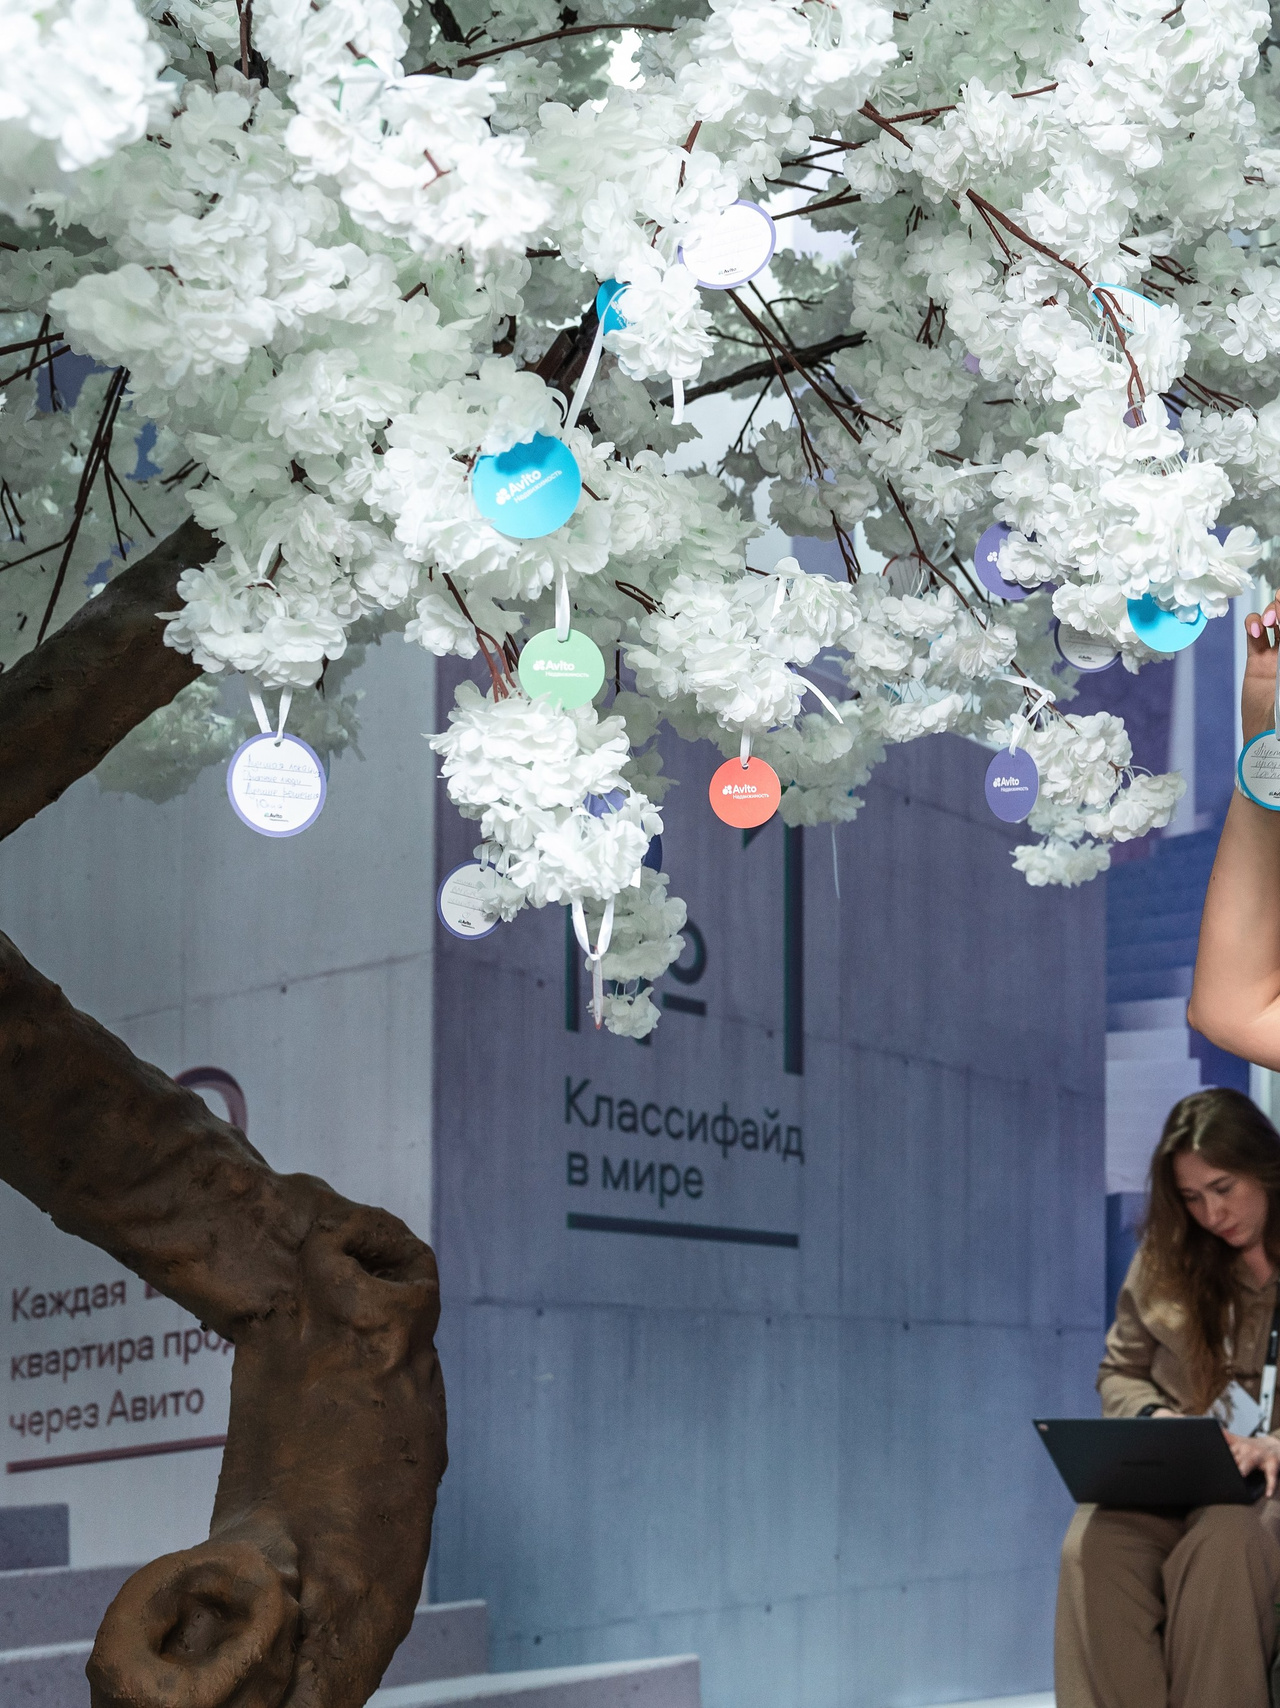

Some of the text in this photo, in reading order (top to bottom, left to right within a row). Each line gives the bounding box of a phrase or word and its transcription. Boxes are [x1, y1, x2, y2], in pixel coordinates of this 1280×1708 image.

[508, 470, 542, 497] Avito
[545, 660, 575, 671] Avito
[733, 784, 757, 794] Avito
[1000, 777, 1019, 787] Avito
[564, 1075, 804, 1165] Классифайд
[567, 1151, 703, 1209] в мире
[12, 1279, 127, 1322] Каждая
[11, 1334, 154, 1384] квартира
[9, 1388, 205, 1443] через Авито
